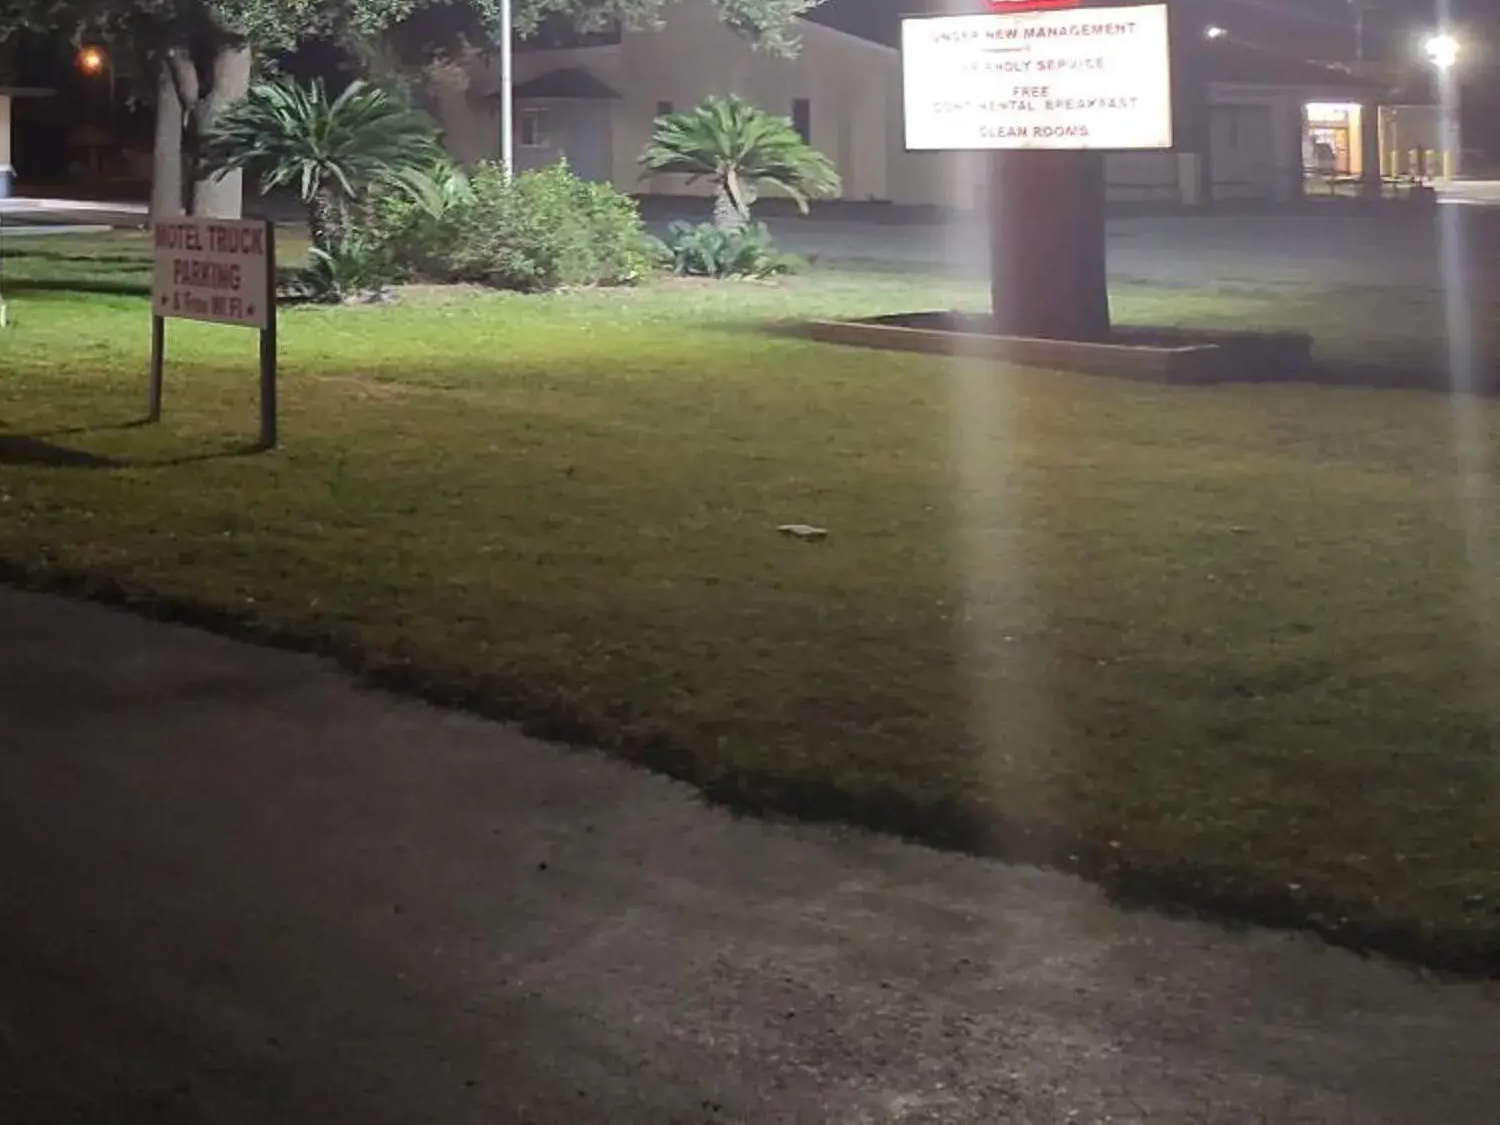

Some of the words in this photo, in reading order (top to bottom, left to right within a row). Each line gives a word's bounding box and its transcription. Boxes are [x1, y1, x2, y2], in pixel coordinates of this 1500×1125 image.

[985, 28, 1018, 40] NEW
[1023, 22, 1137, 40] MANAGEMENT
[1012, 86, 1049, 98] FREE
[1045, 96, 1138, 111] BREAKFAST
[979, 126, 1028, 139] CLEAN
[1033, 125, 1090, 138] ROOMS
[207, 226, 264, 255] TRUCK
[173, 258, 241, 291] PARKING
